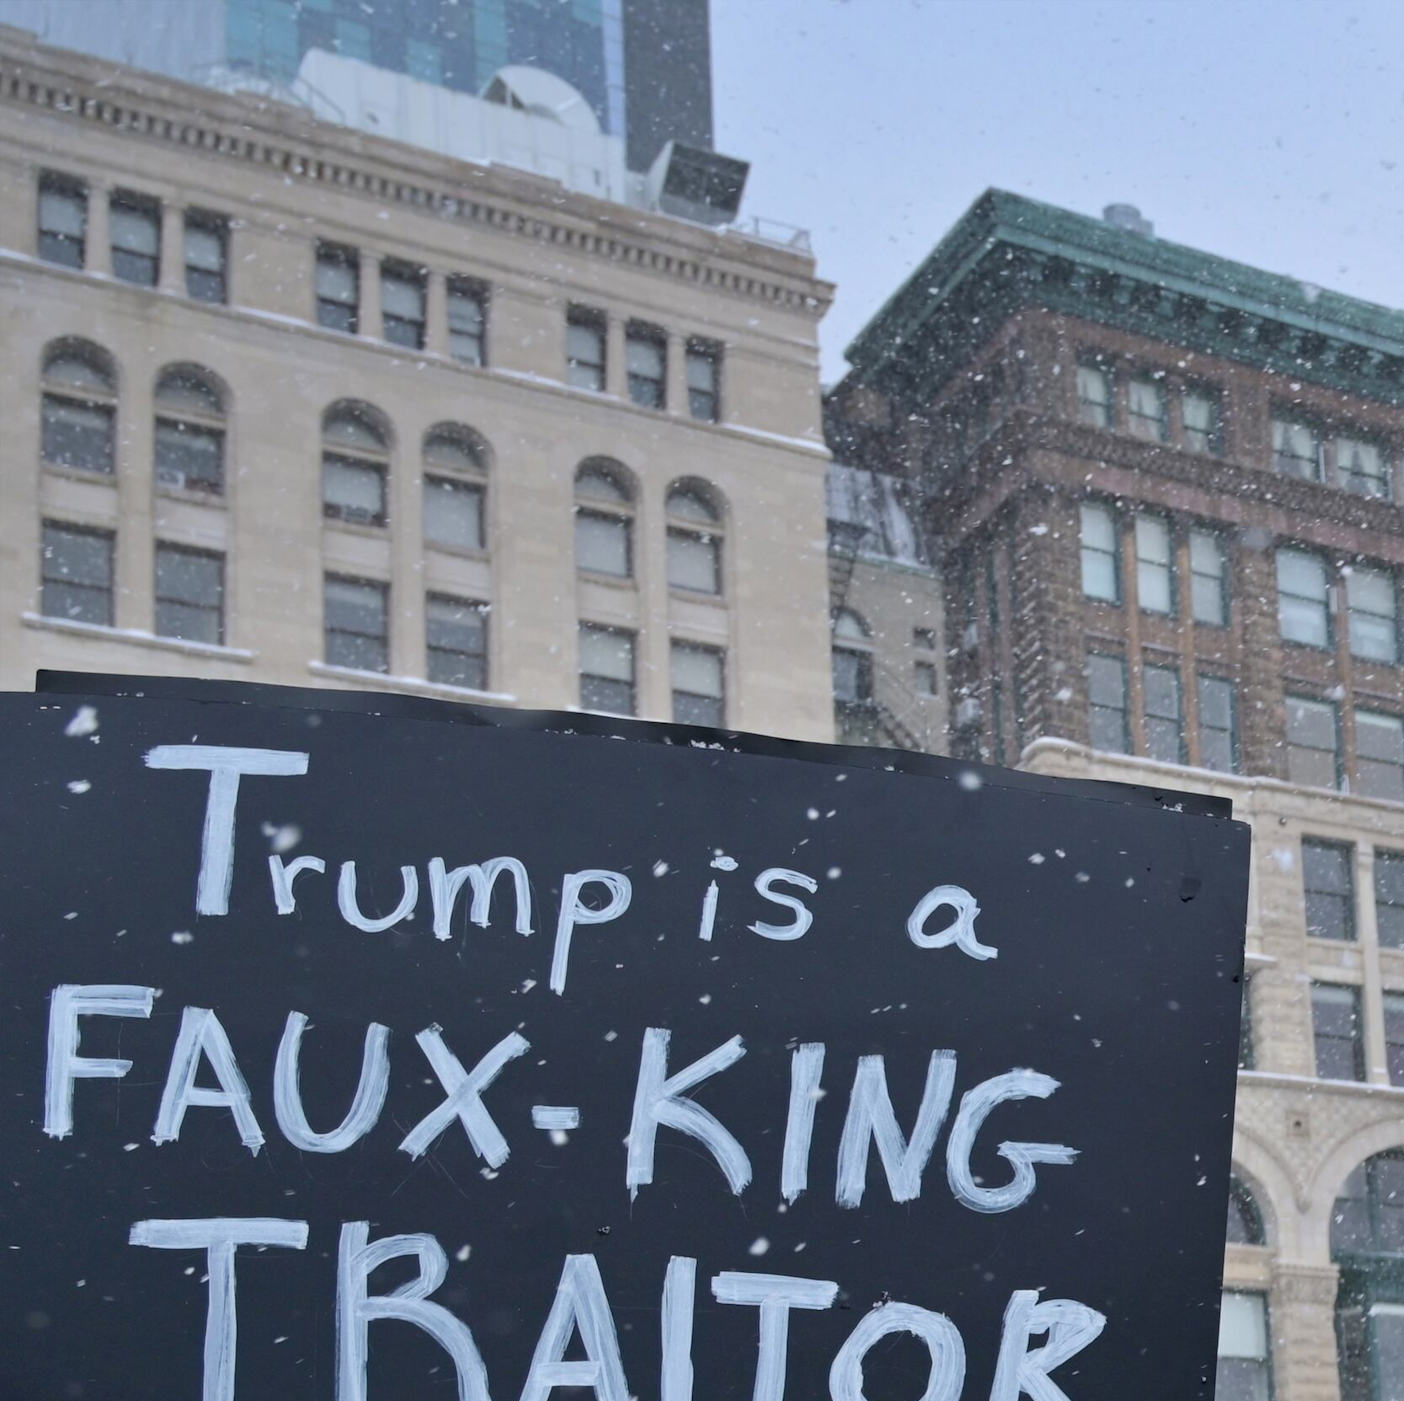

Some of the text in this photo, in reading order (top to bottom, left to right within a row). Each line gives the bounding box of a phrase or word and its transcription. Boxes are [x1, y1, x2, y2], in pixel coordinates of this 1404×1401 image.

[142, 744, 999, 996] Trump is a
[42, 984, 1081, 1214] FAUX-KING
